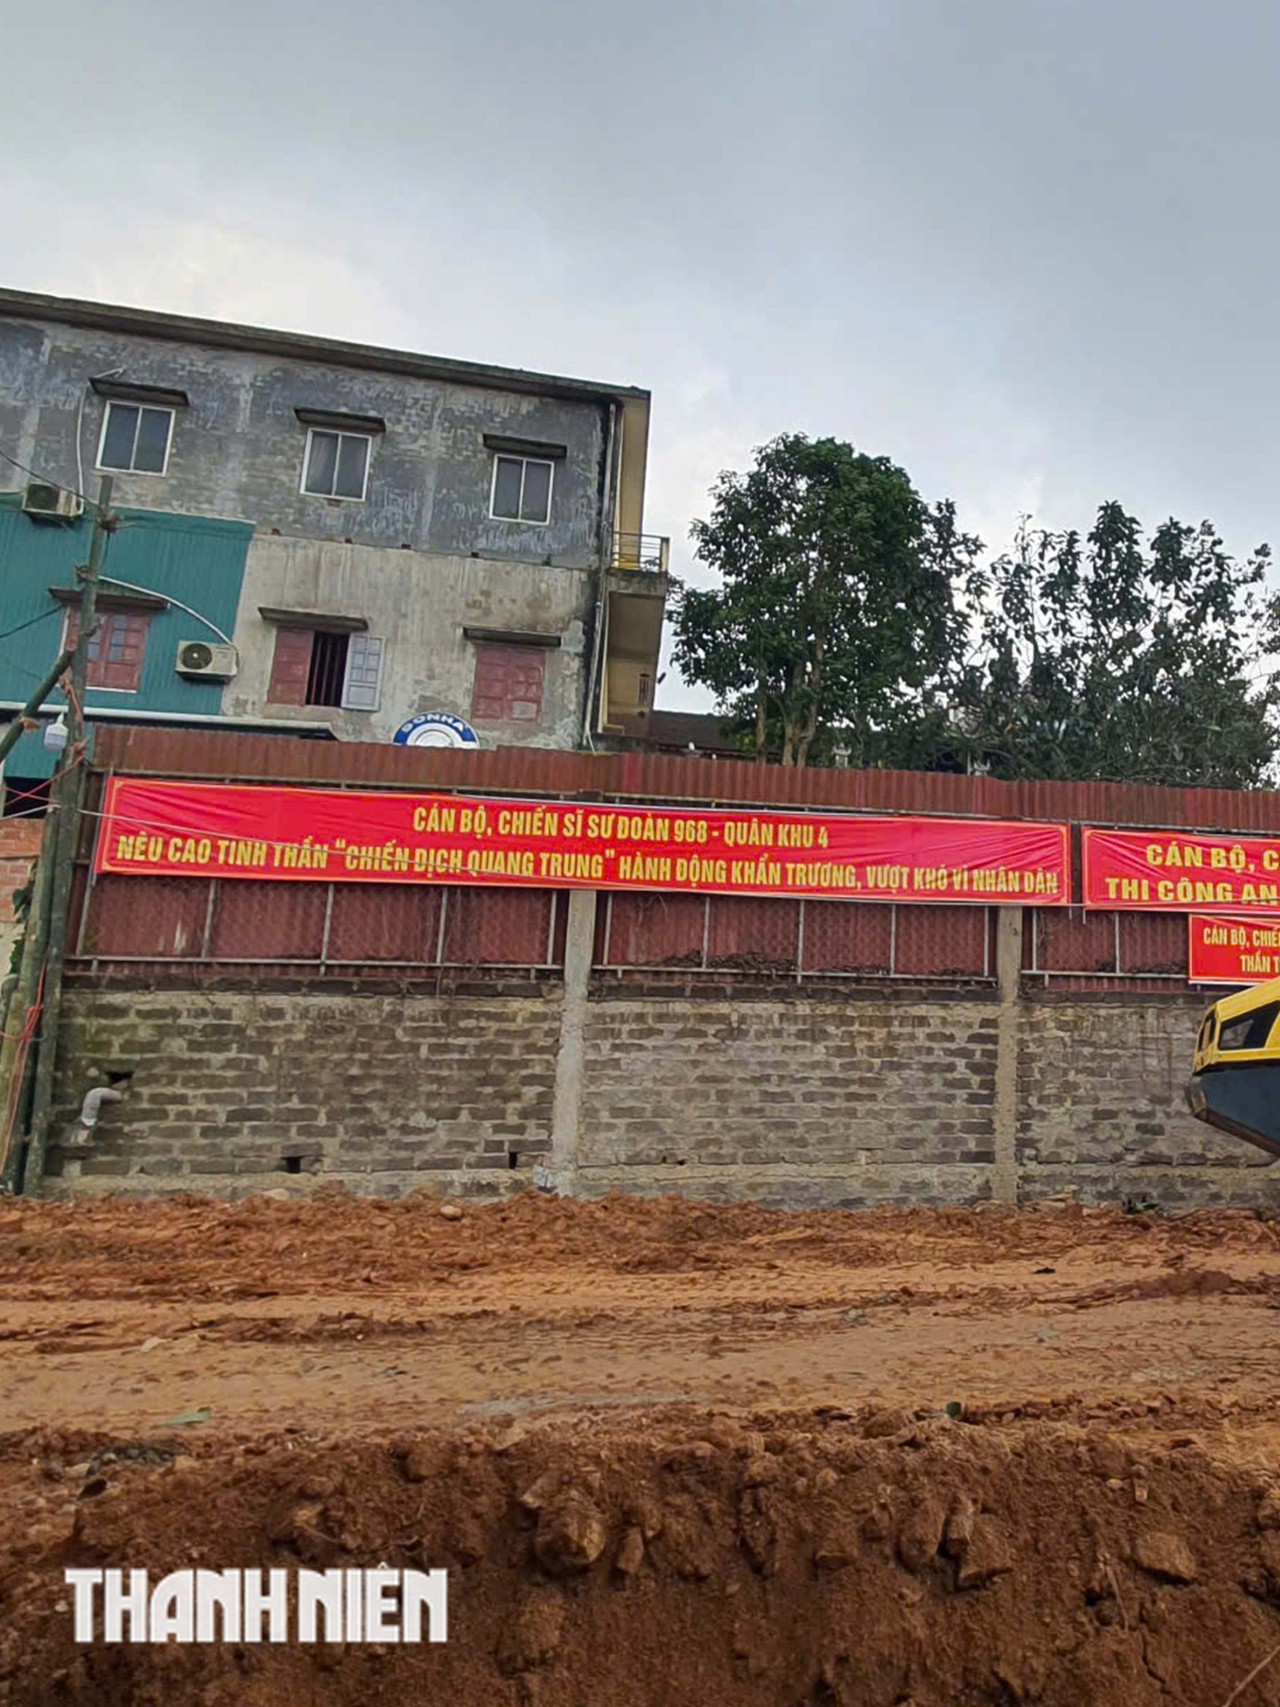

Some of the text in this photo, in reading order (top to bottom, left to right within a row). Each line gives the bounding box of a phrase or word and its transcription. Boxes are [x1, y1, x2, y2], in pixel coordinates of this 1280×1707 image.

[414, 803, 456, 833] CÁN
[460, 805, 493, 839] BỘ,
[498, 804, 559, 836] CHIẾN
[562, 809, 584, 837] SĨ
[588, 813, 615, 838] SƯ
[617, 812, 670, 841] ĐOÀN
[674, 818, 708, 842] 968
[724, 817, 774, 847] QUÂN
[778, 824, 814, 848] KHU
[818, 826, 829, 848] 4
[116, 831, 164, 862] NÊU
[168, 837, 212, 864] CAO
[217, 840, 267, 866] TINH
[413, 847, 462, 878] DỊCH
[467, 850, 534, 877] QUANG
[619, 851, 671, 881] HÀNH
[675, 854, 727, 888] ĐỘNG
[731, 852, 781, 886] KHẨN
[866, 863, 910, 895] VƯỢT
[914, 864, 947, 890] KHÓ
[953, 864, 969, 891] VÌ
[973, 866, 1020, 893] NHÂN
[1024, 867, 1058, 894] DÂN
[1146, 841, 1203, 867] CÁN
[1211, 844, 1255, 873] BỘ,
[1105, 877, 1149, 900] THI
[1158, 876, 1233, 903] CÔNG
[1241, 884, 1278, 906] AN
[1203, 924, 1229, 946] CÁN
